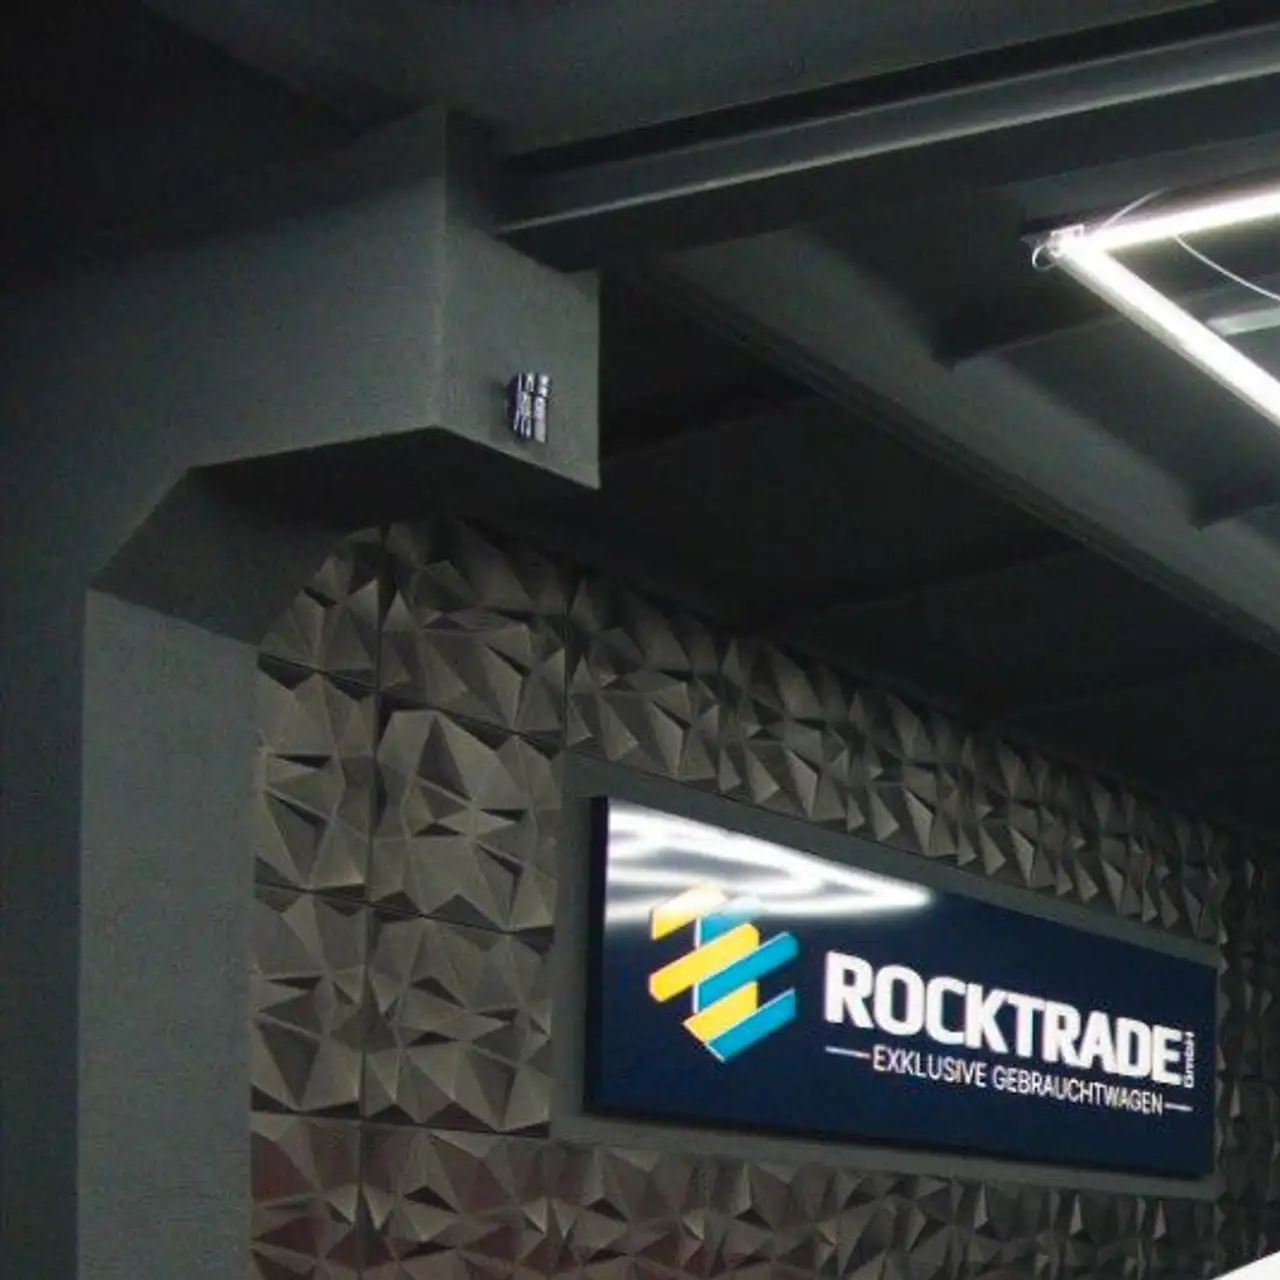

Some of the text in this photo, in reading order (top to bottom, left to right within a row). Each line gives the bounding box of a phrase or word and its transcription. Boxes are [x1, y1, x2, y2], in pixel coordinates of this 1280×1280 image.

[824, 950, 1182, 1086] ROCKTRADE
[873, 1044, 1164, 1115] EXKLUSIVE GEBRAUCHTWAGEN
